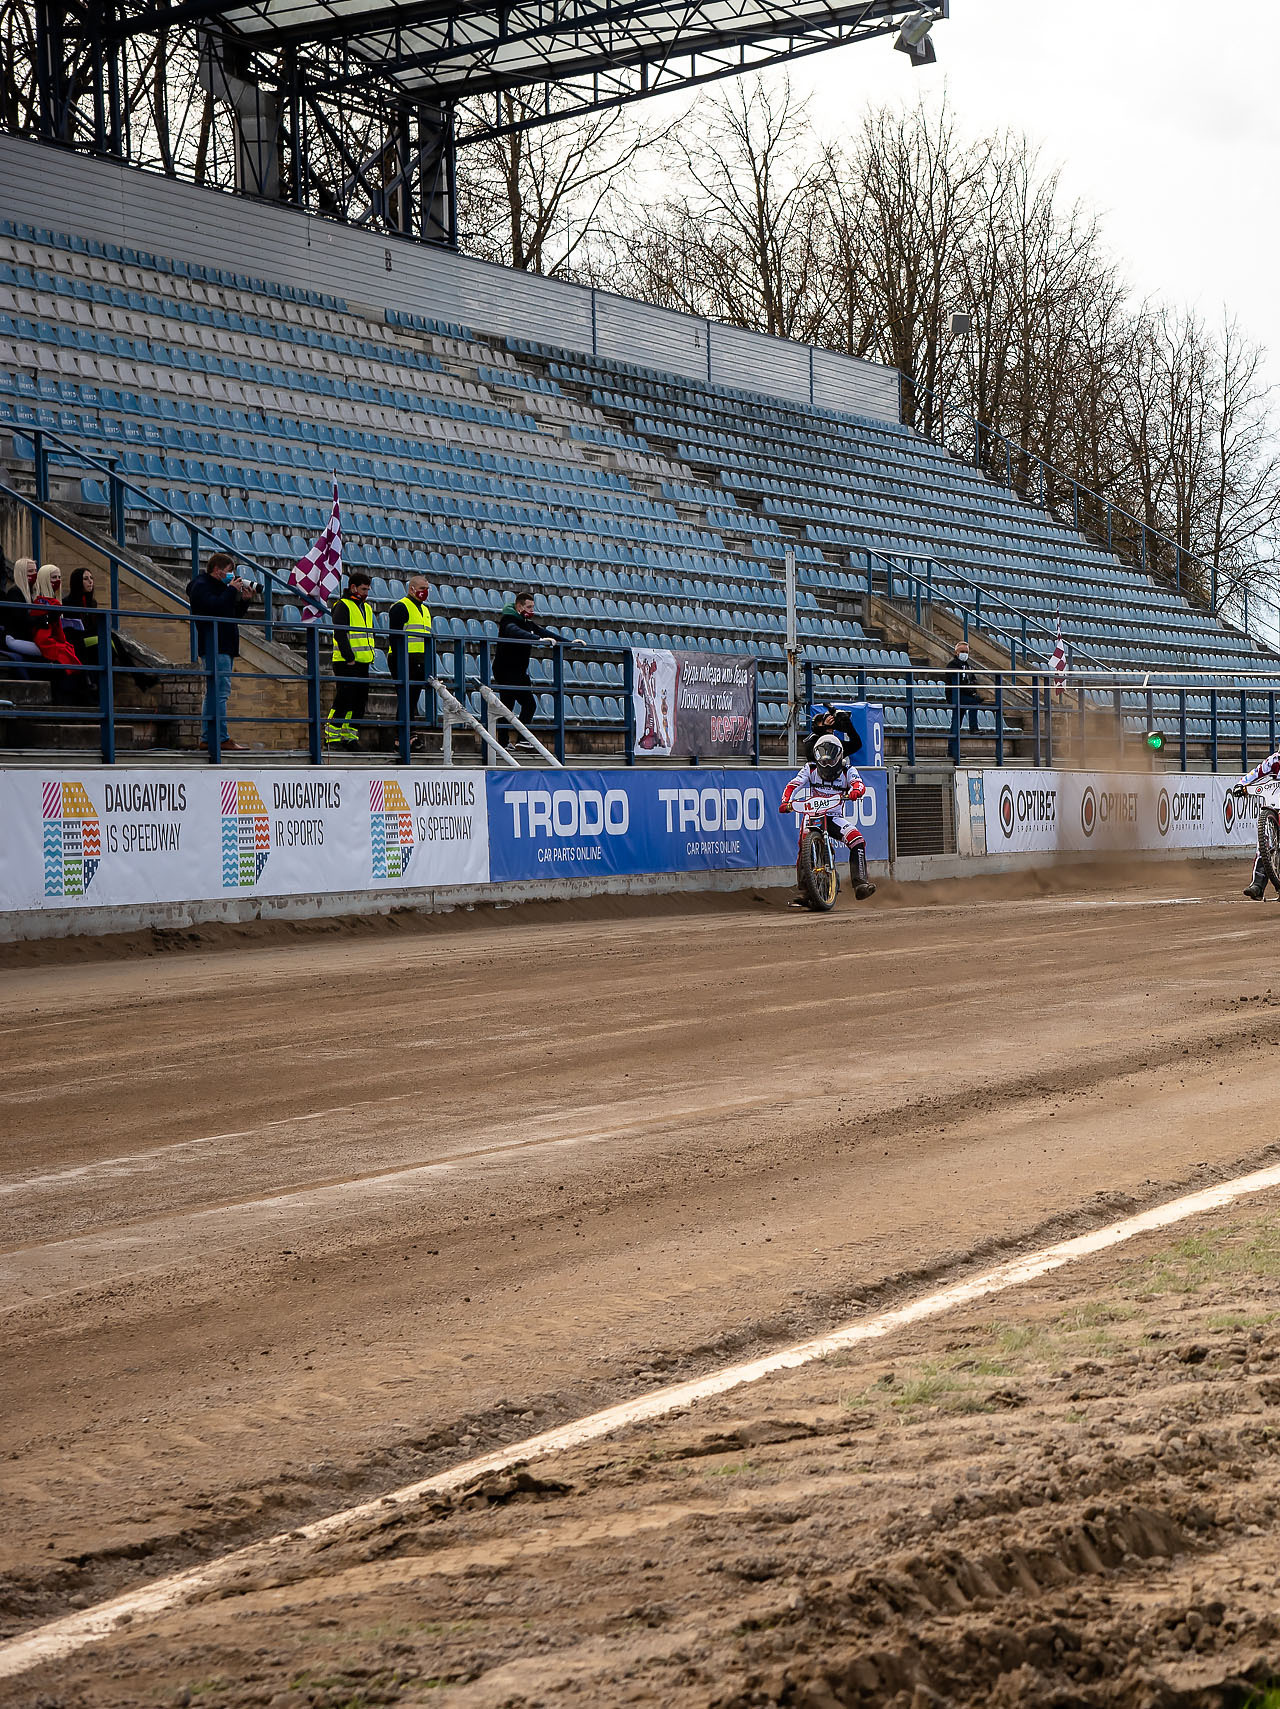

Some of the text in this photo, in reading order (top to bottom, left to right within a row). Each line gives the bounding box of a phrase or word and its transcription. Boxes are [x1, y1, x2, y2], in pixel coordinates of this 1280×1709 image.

[683, 661, 699, 685] Будь
[699, 663, 721, 685] победа
[734, 665, 748, 687] беда
[716, 692, 733, 711] тобой
[104, 783, 187, 812] DAUGAVPILS
[273, 782, 341, 809] DAUGAVPILS
[414, 781, 475, 807] DAUGAVPILS
[814, 800, 830, 808] BAU
[1017, 790, 1057, 821] OPTIBET
[1100, 792, 1138, 822] OPTIBET
[1172, 793, 1206, 821] OPTIBET
[504, 789, 630, 838] TRODO
[658, 787, 765, 832] TRODO
[106, 823, 181, 853] IS SPEEDWAY
[275, 819, 324, 847] IR SPORTS
[416, 816, 472, 841] IS SPEEDWAY
[537, 846, 602, 862] CAR PARTS ONLINE
[686, 841, 740, 855] CAR PARTS ONLINE
